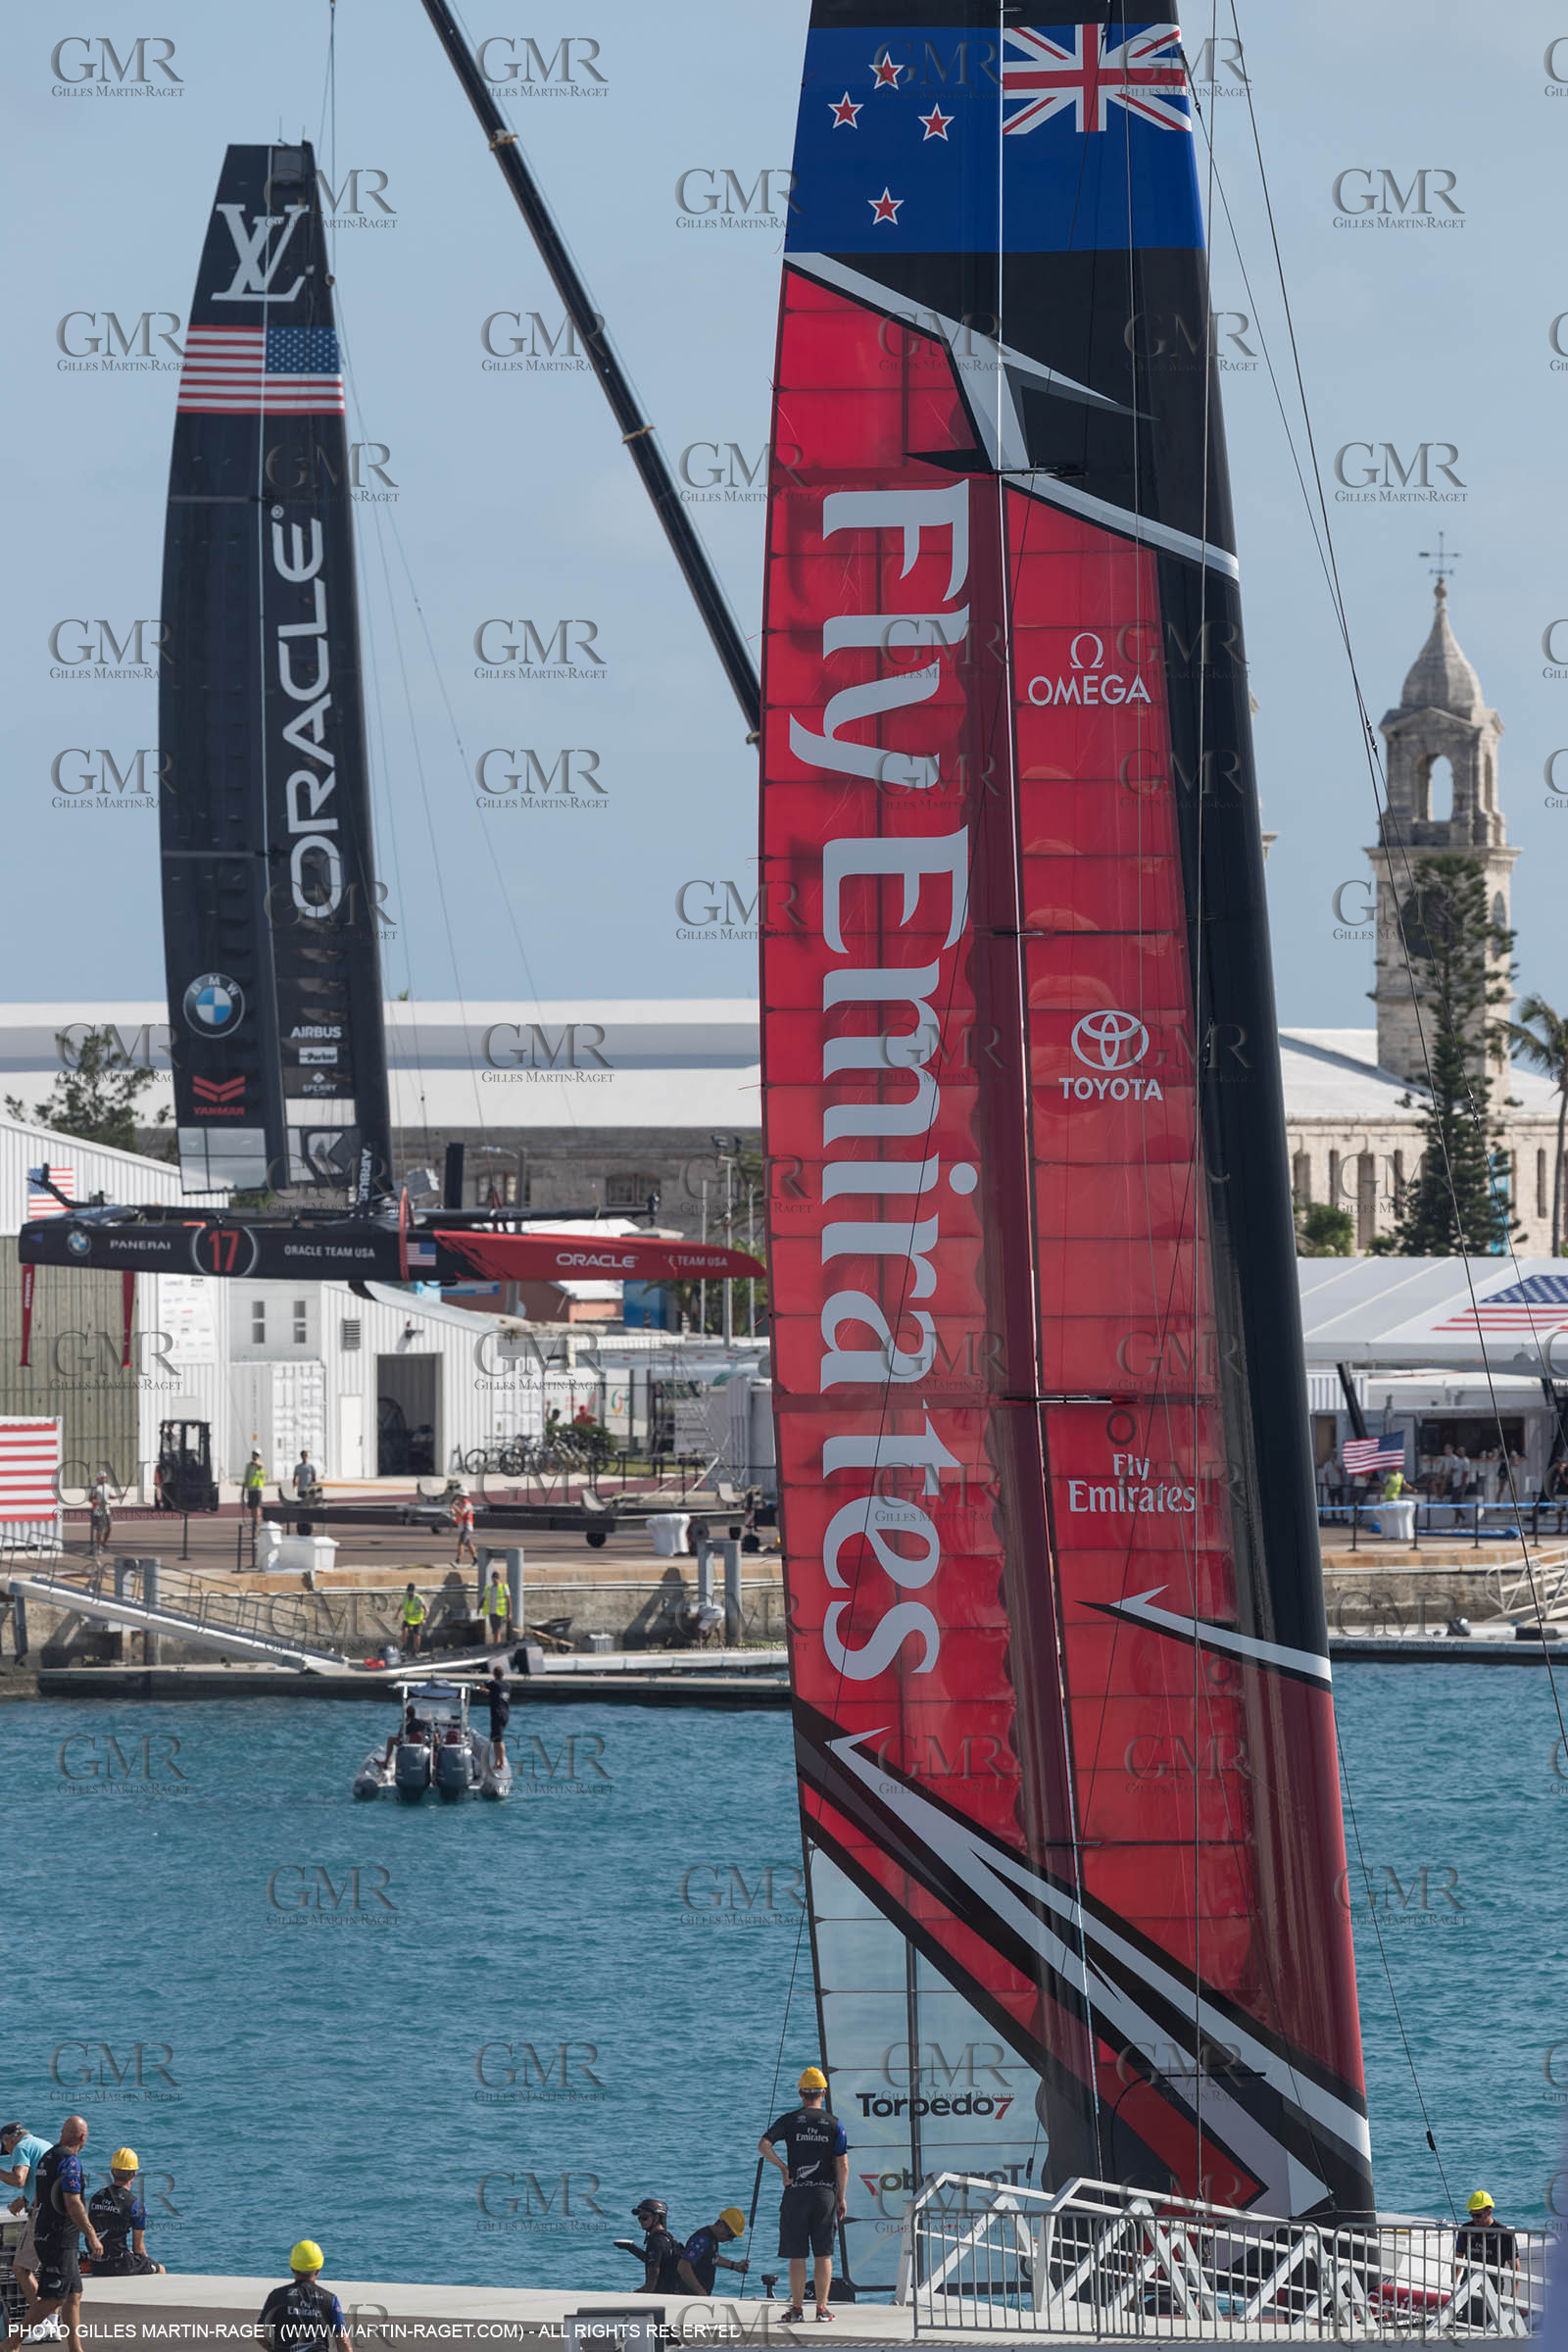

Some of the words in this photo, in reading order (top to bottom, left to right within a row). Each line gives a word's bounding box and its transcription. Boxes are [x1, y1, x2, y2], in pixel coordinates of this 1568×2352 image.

[1028, 674, 1152, 707] OMEGA
[271, 516, 342, 918] ORACLE
[290, 1026, 342, 1038] AIRBUS
[1058, 1076, 1163, 1102] TOYOTA
[359, 1148, 372, 1202] AIRBUS
[109, 1239, 172, 1250] PANERAI
[209, 1230, 239, 1273] 17
[284, 1244, 322, 1256] ORACLE
[324, 1246, 353, 1257] TEAM
[355, 1248, 375, 1258] USA
[556, 1252, 636, 1269] ORACLE
[677, 1255, 706, 1266] TEAM
[708, 1255, 728, 1267] USA
[1113, 1453, 1150, 1482] Fly
[1067, 1478, 1197, 1513] Emirates
[856, 2092, 1015, 2120] Torpedo7
[796, 2133, 829, 2143] Emirates
